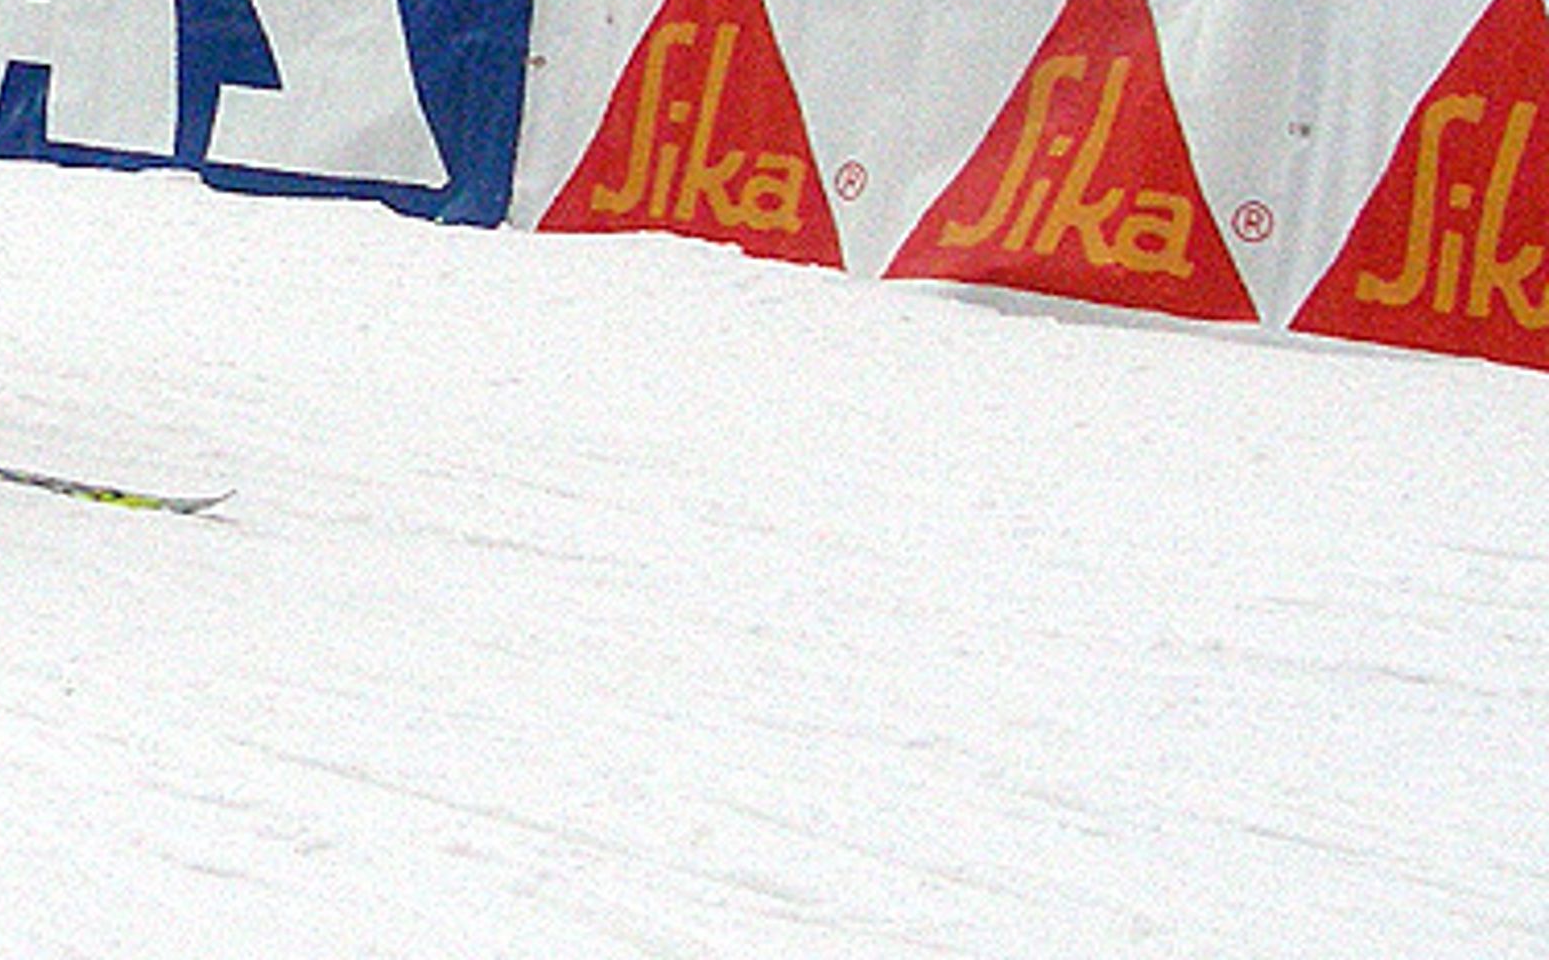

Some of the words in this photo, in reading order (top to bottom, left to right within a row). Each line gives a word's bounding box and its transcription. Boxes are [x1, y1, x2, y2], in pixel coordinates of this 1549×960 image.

[590, 21, 804, 233] Sika
[937, 54, 1194, 278] Sika
[1354, 93, 1549, 330] Sik
